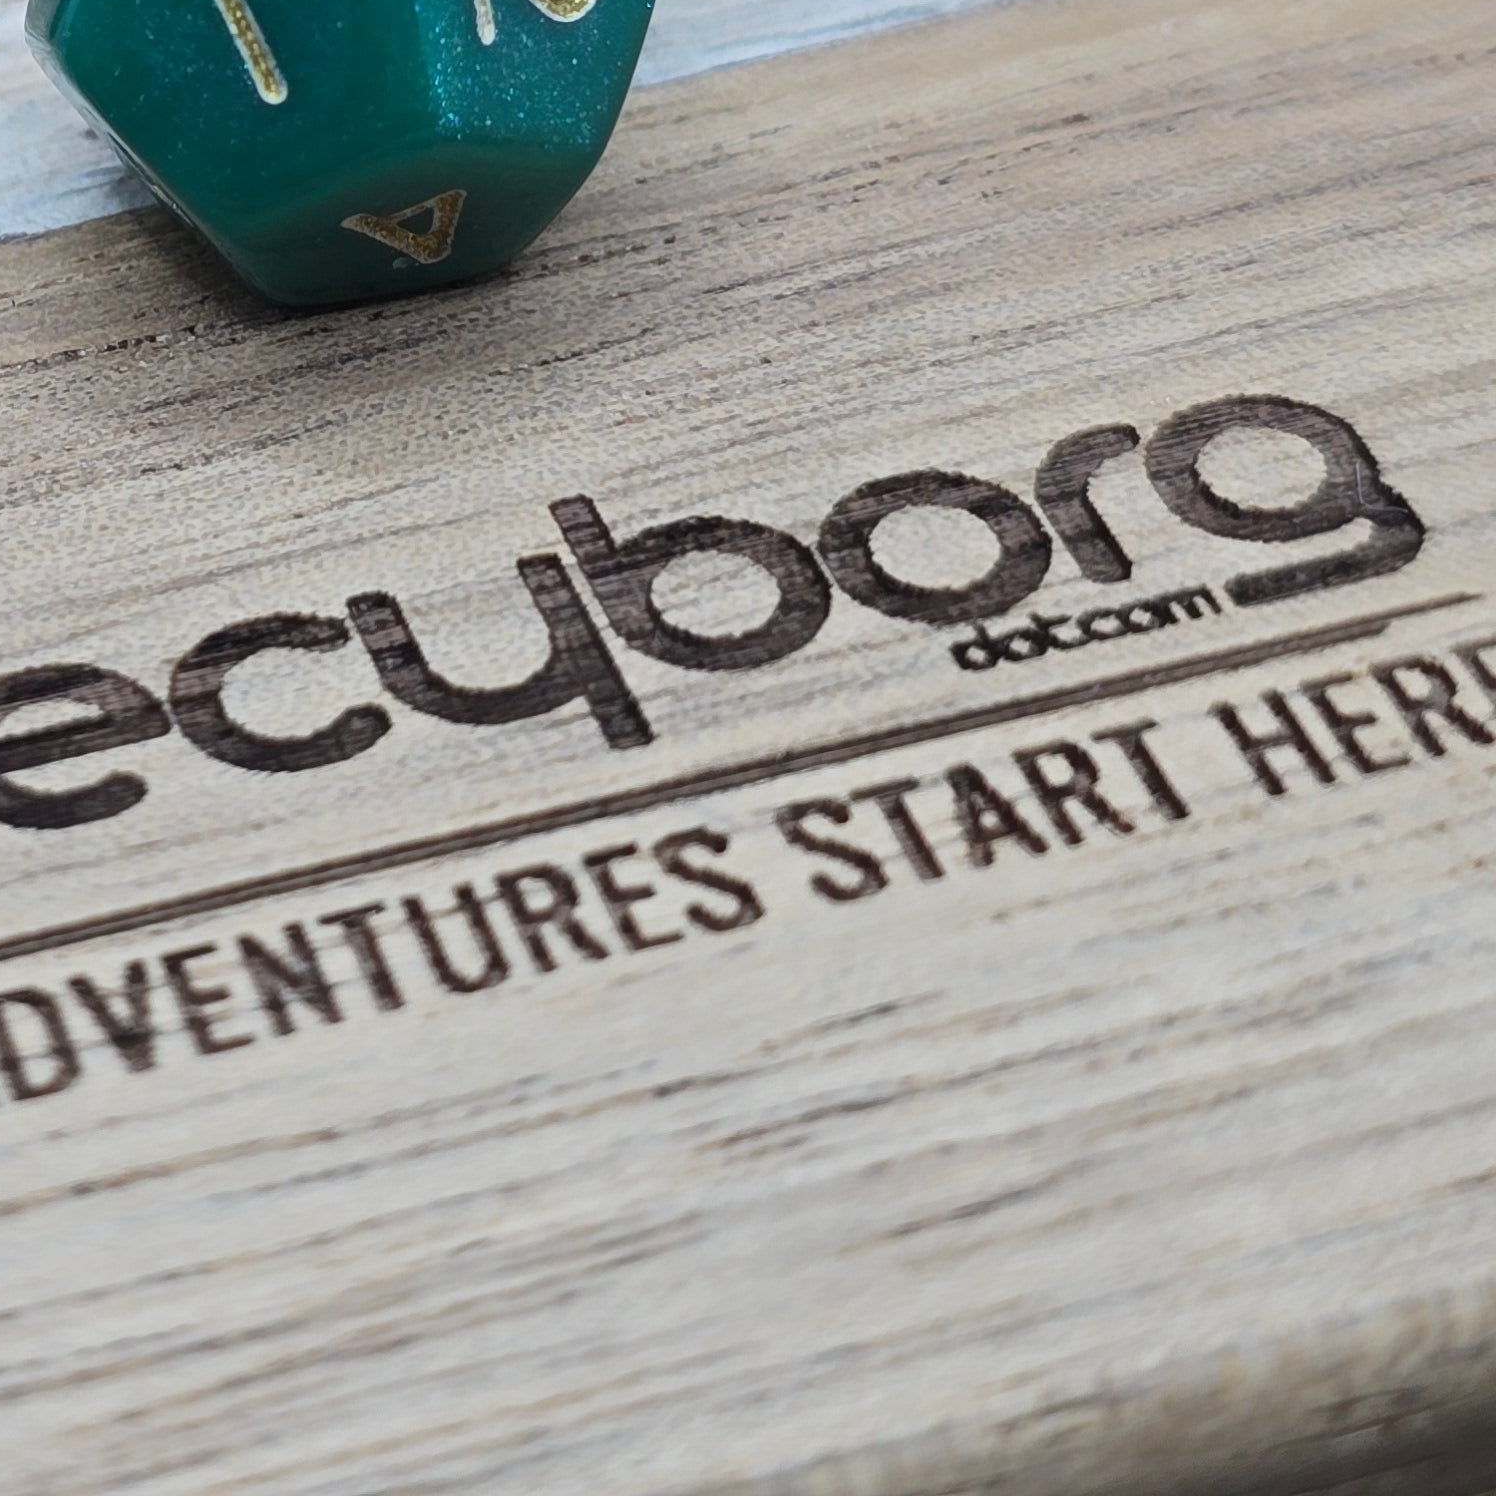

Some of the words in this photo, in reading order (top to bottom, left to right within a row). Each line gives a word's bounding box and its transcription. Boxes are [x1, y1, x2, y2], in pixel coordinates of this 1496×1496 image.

[340, 188, 467, 265] 4
[949, 583, 1223, 671] dotcom
[774, 715, 1192, 902] START
